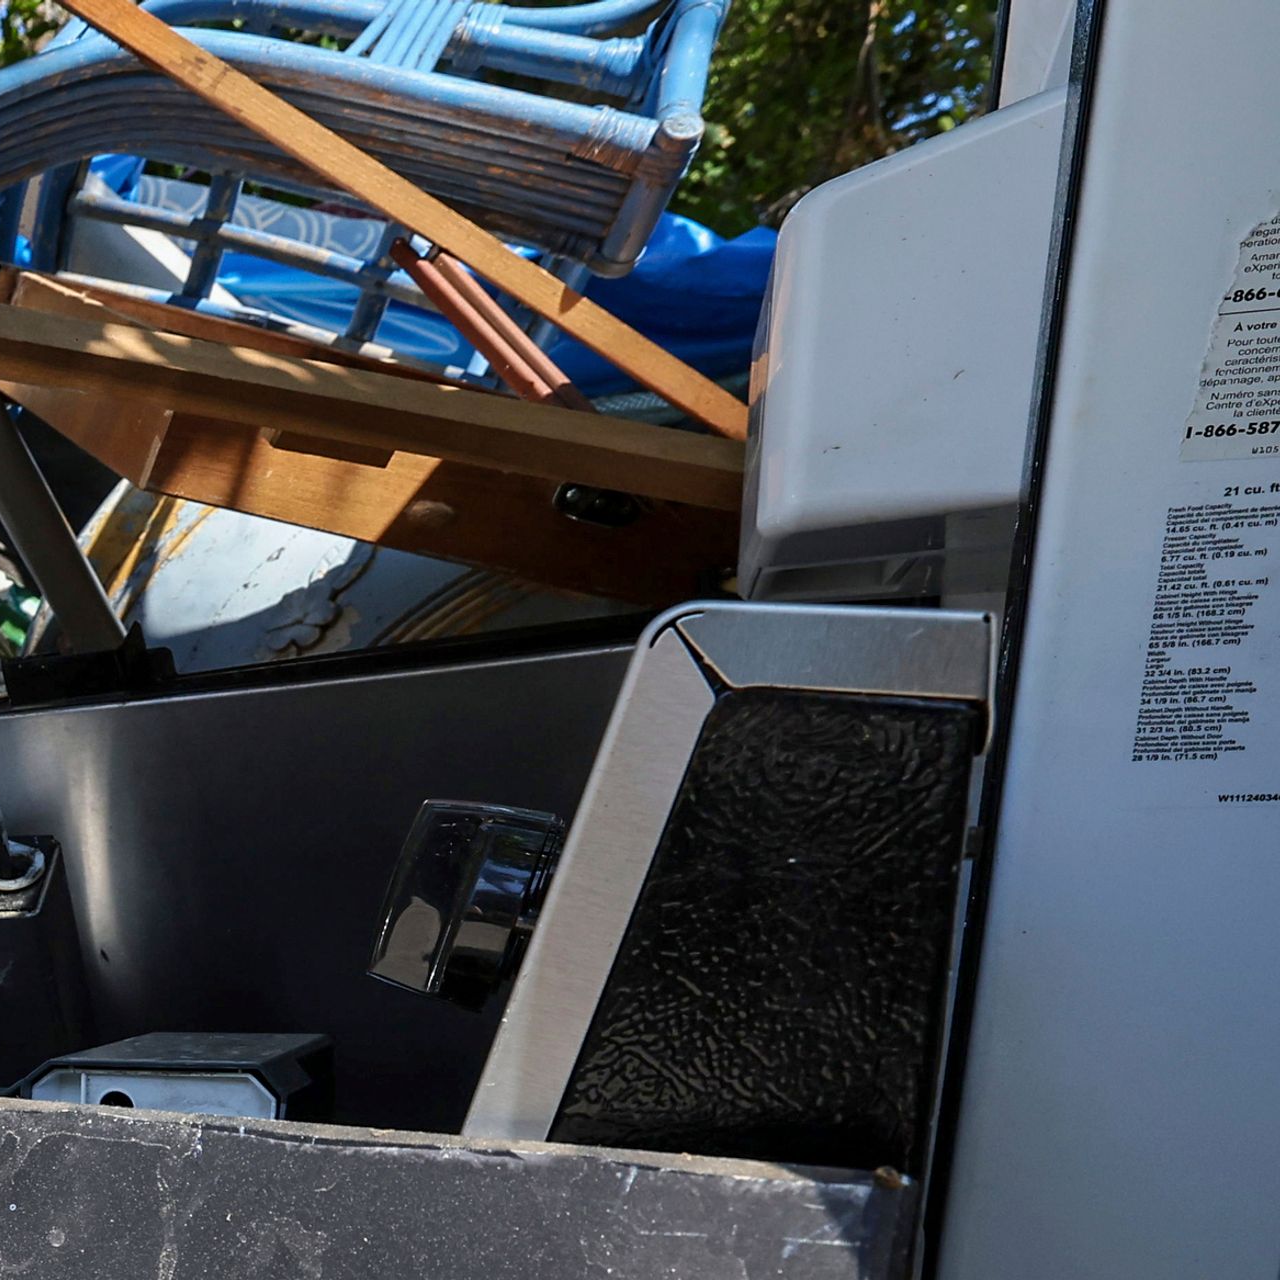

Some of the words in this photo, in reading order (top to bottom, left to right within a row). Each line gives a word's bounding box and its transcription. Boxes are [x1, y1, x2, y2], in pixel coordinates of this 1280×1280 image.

[1247, 322, 1277, 330] votre
[1206, 400, 1242, 410] Centre
[1233, 410, 1243, 418] la
[1224, 486, 1240, 497] 21
[1244, 486, 1265, 495] cu.
[1218, 794, 1280, 802] W11124034
